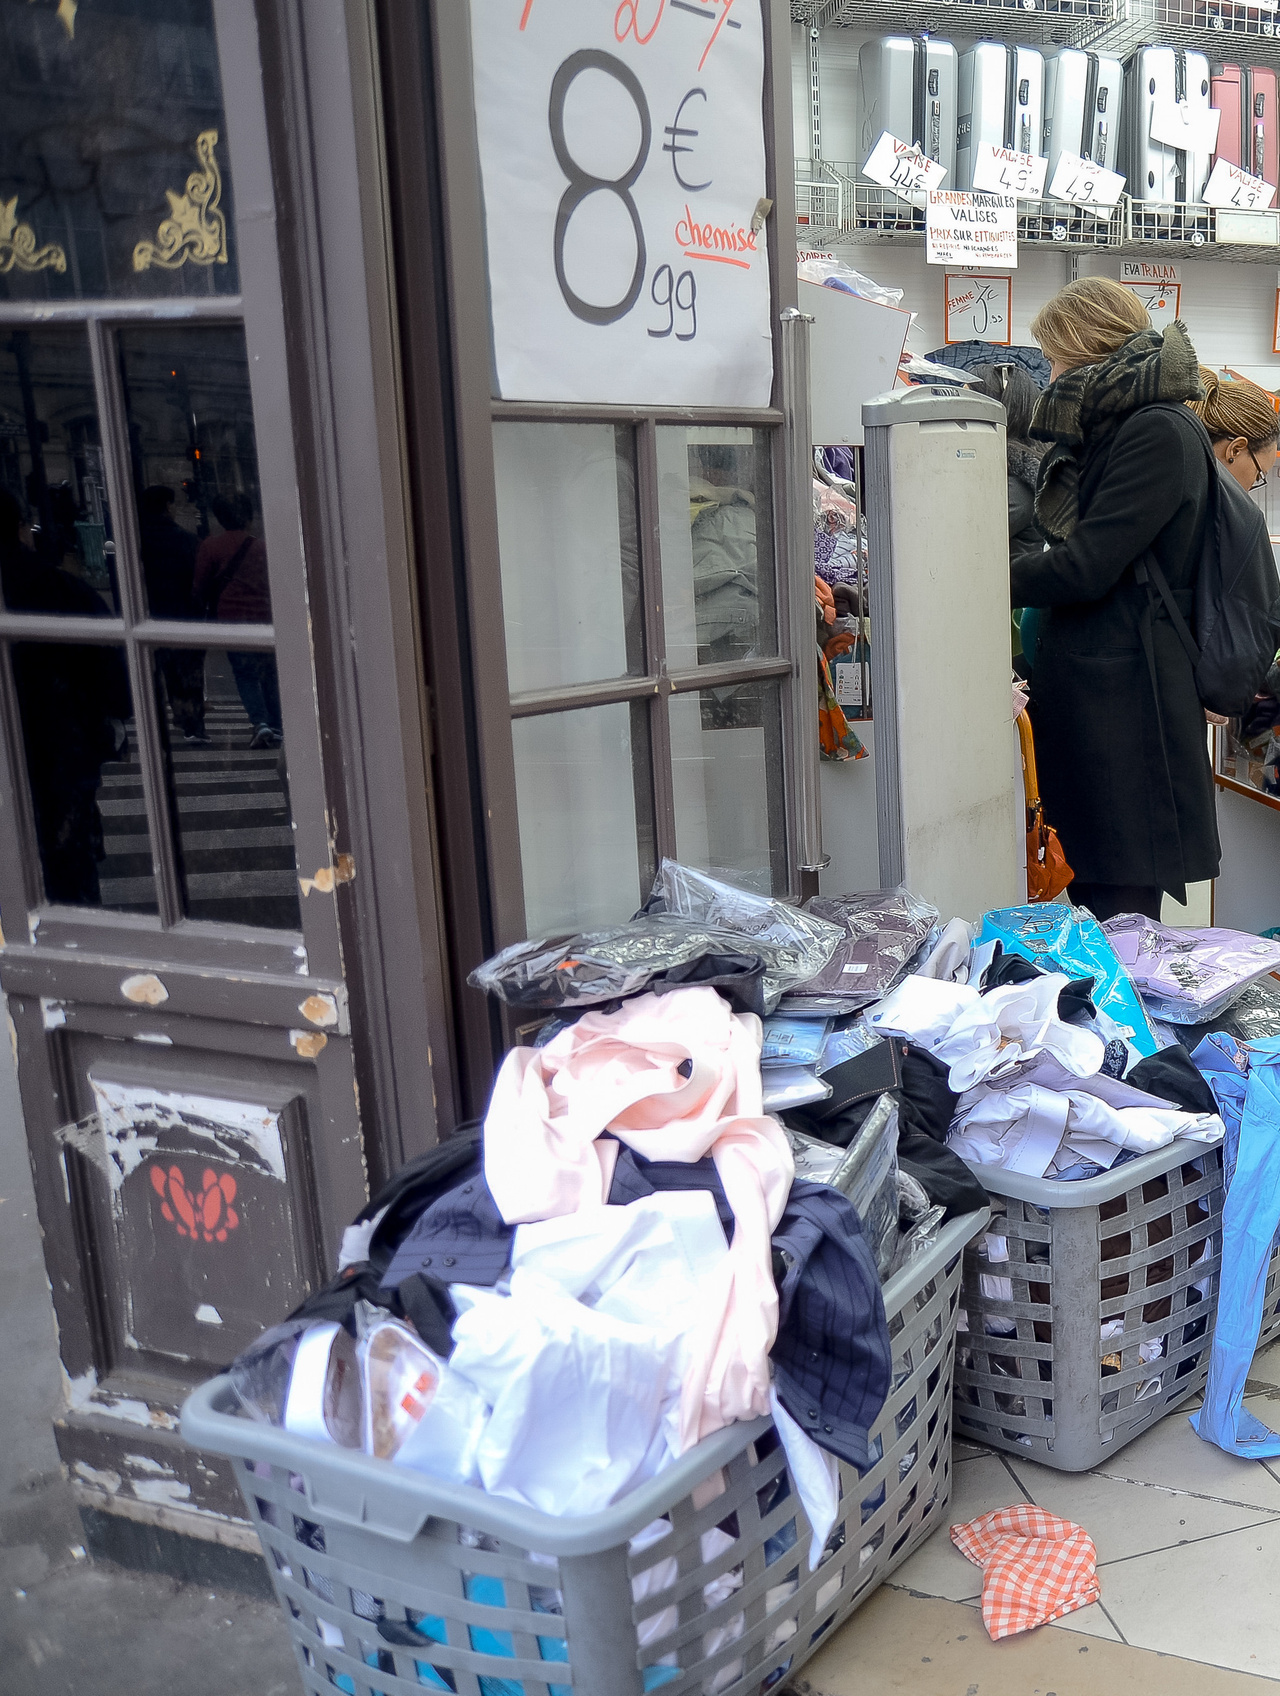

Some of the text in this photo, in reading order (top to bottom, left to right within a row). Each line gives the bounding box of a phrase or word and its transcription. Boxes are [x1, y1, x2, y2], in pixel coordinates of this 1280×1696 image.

[548, 48, 712, 326] 8 €
[675, 204, 757, 251] chemise
[930, 226, 953, 240] PRIX
[953, 228, 974, 241] SUR
[647, 263, 697, 341] 99
[947, 290, 975, 311] FEMME
